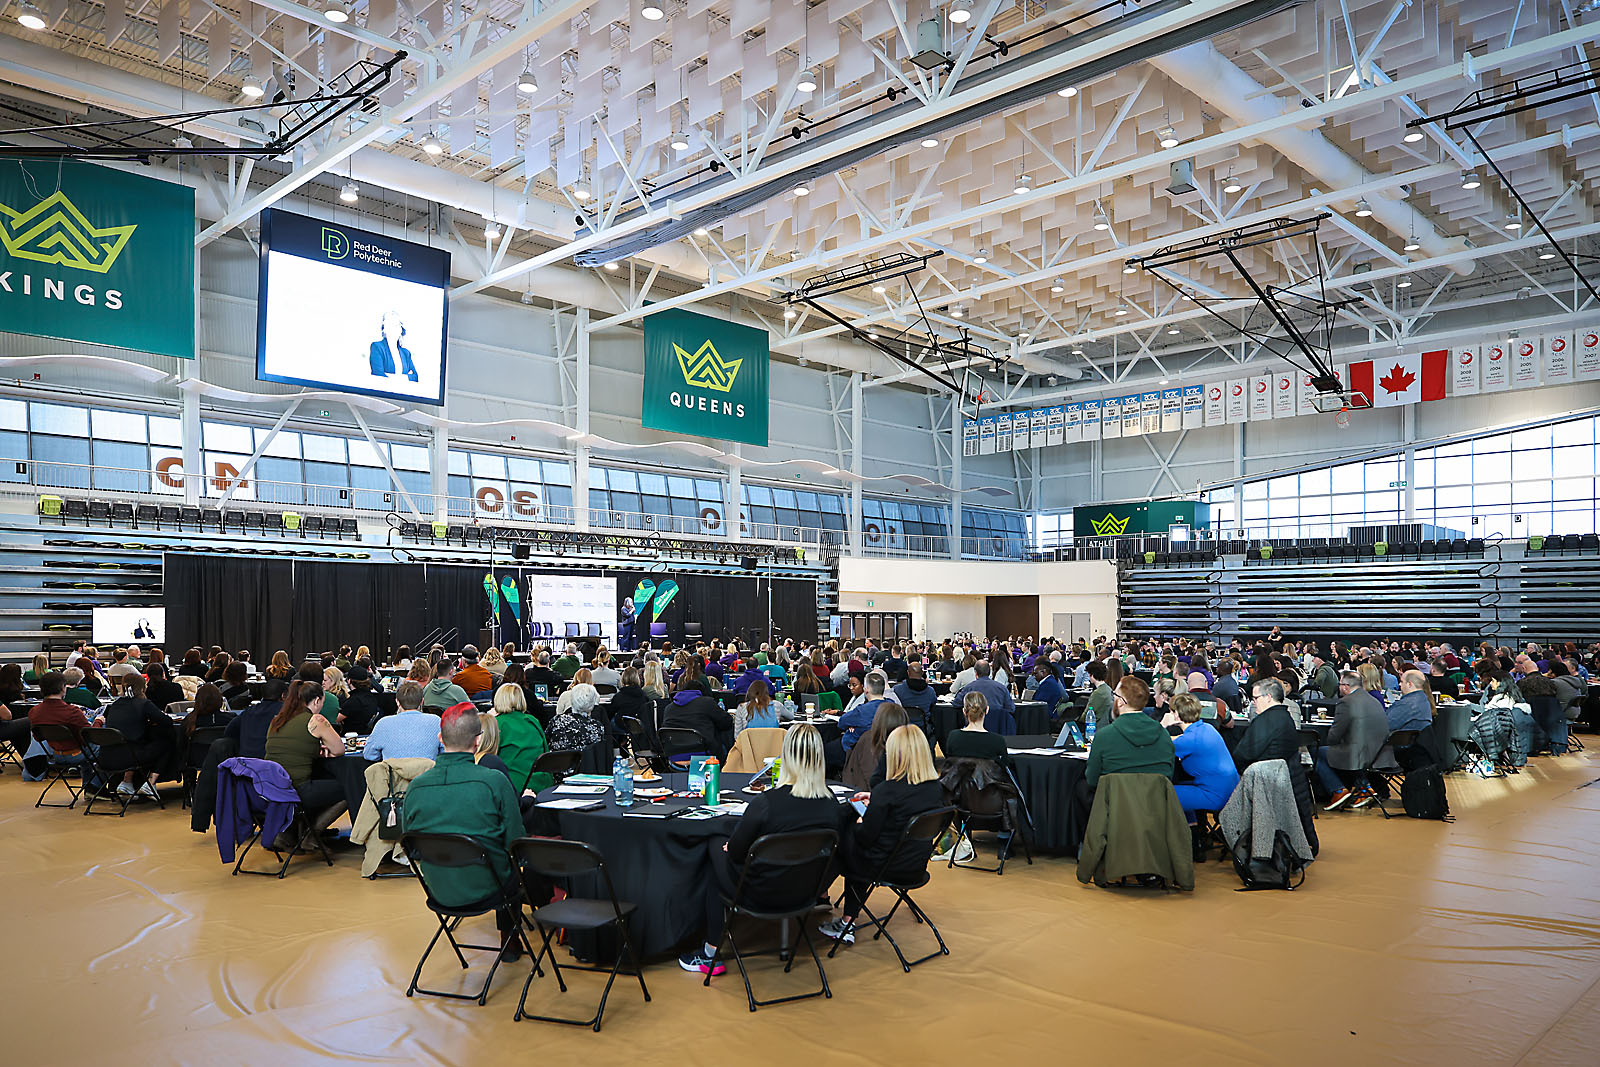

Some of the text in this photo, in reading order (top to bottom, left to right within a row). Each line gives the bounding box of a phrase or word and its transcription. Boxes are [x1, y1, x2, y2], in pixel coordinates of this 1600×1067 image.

[354, 241, 392, 257] Red Deer
[354, 250, 402, 268] Polytechnic
[0, 272, 123, 310] KINGS
[670, 392, 745, 418] QUEENS
[698, 761, 706, 771] 7
